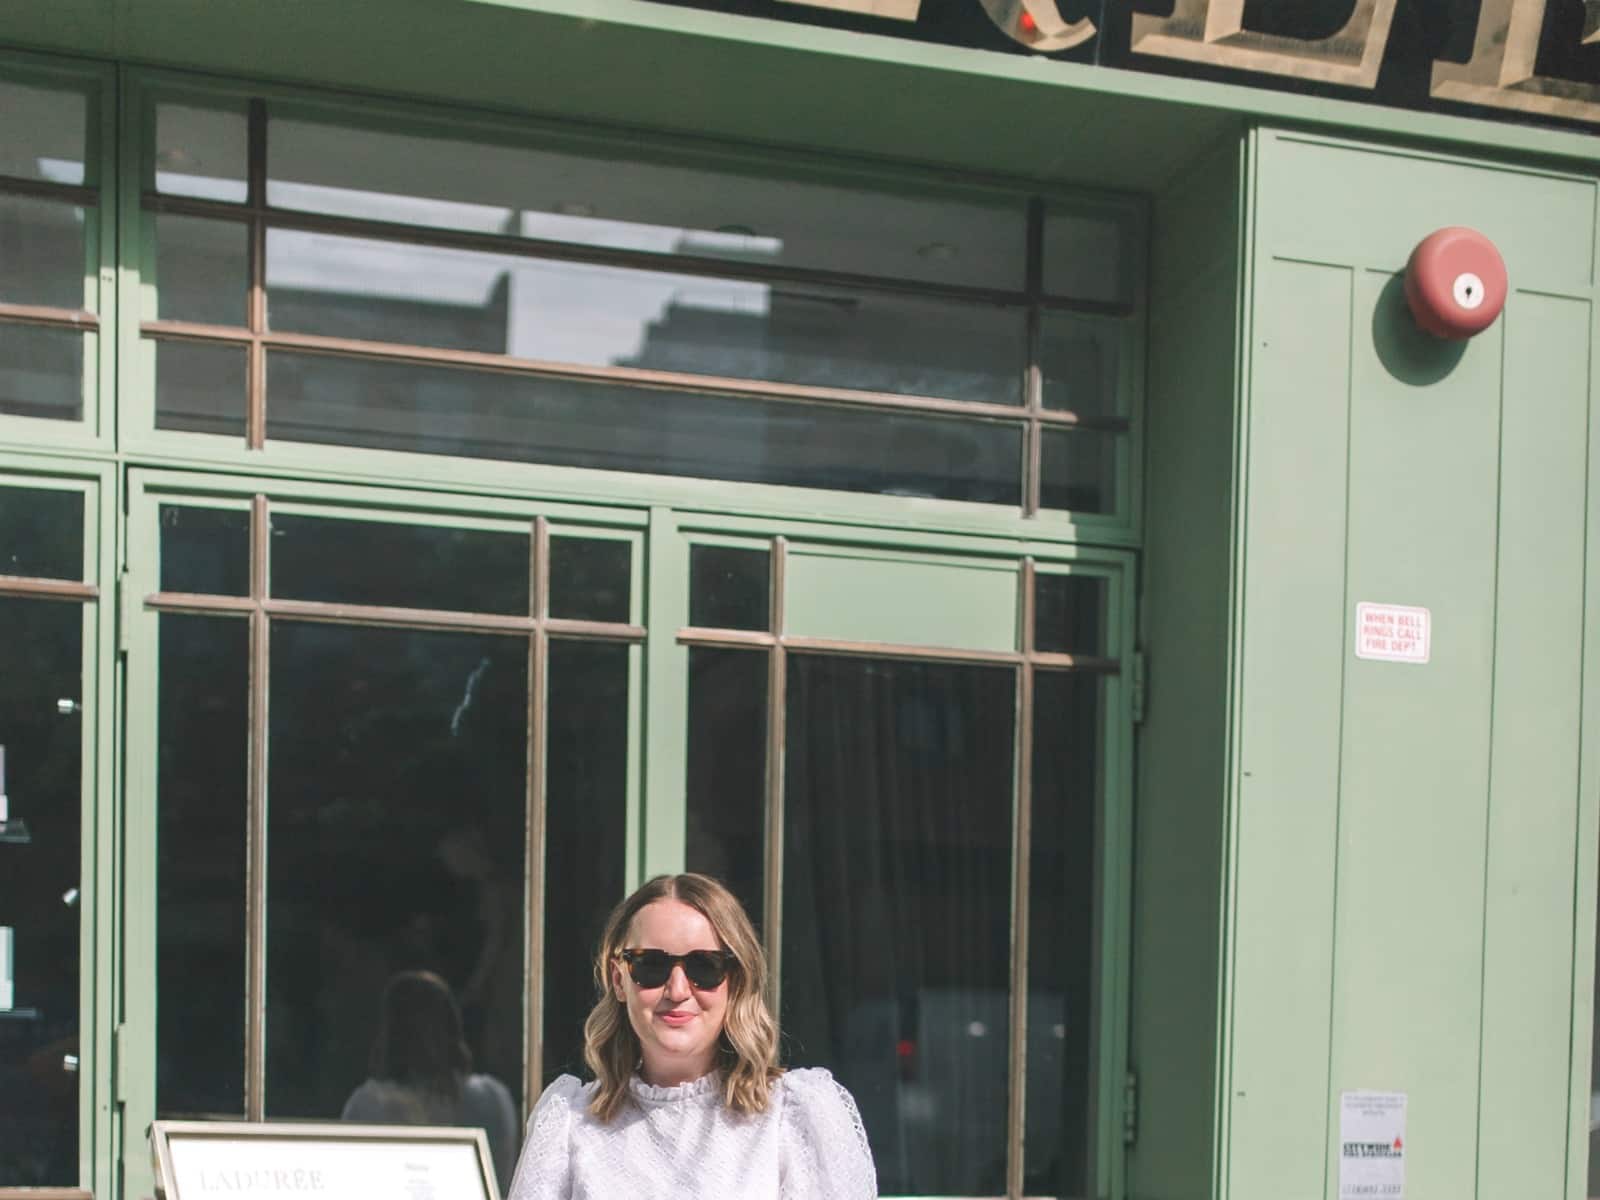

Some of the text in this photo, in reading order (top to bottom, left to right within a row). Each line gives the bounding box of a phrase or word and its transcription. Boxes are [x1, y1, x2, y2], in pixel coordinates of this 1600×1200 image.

[1365, 613, 1422, 628] WHEN BELL
[1363, 625, 1422, 640] RINGS CALL
[1365, 638, 1387, 650] FIRE
